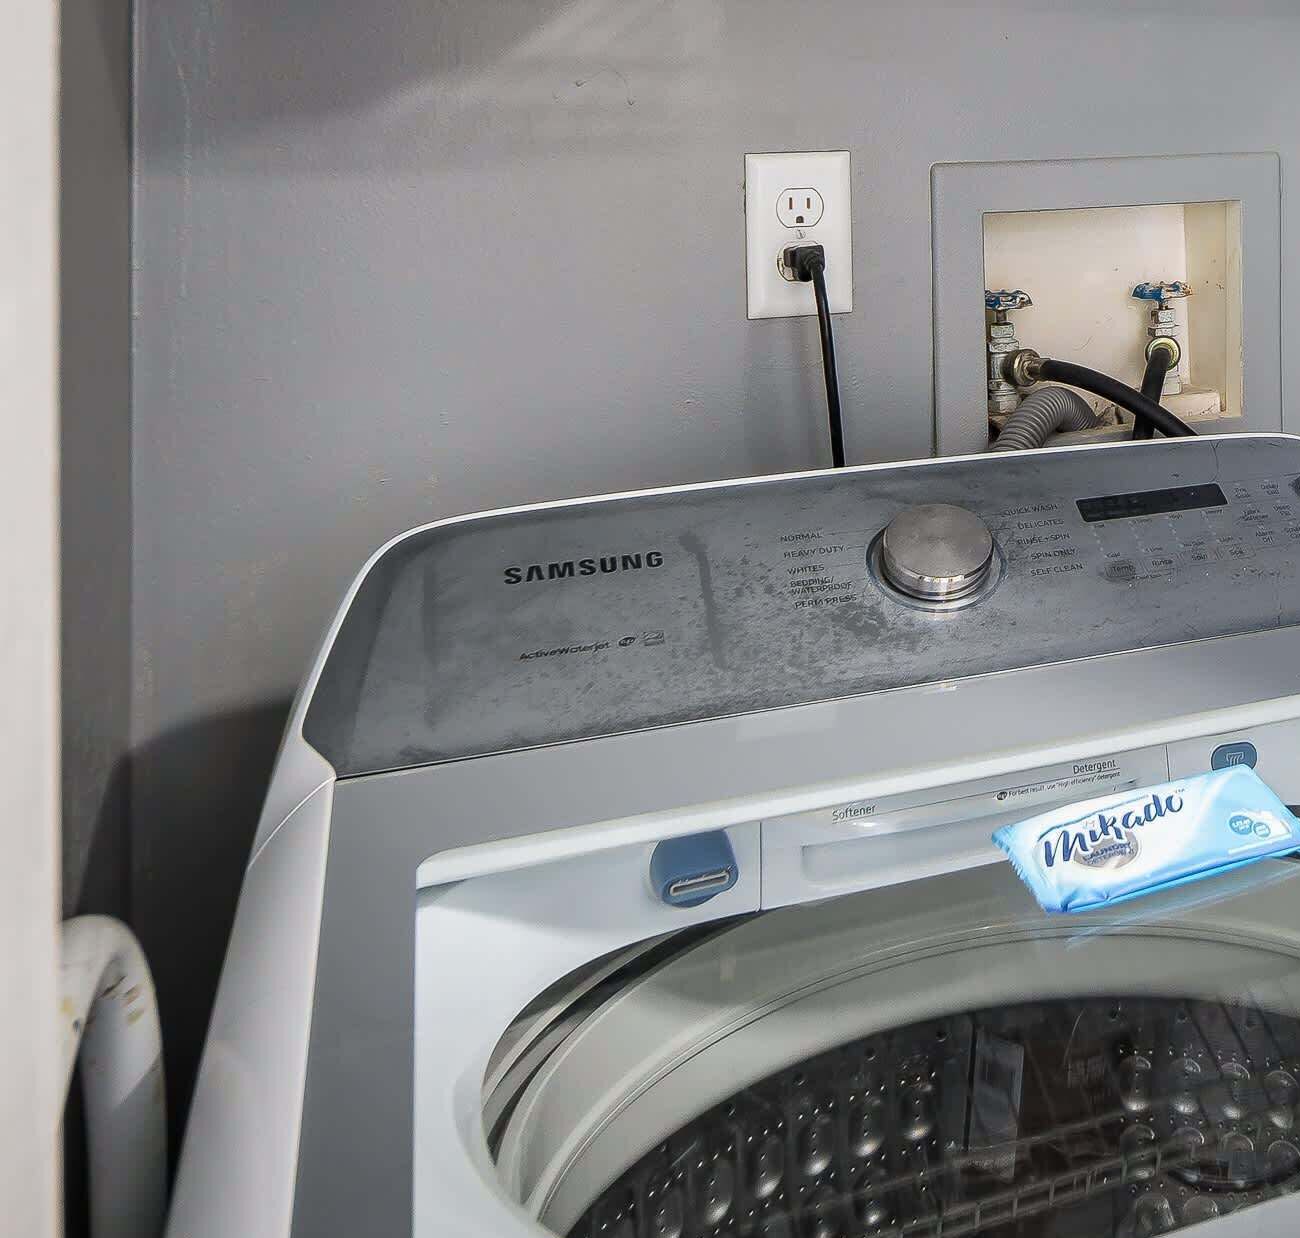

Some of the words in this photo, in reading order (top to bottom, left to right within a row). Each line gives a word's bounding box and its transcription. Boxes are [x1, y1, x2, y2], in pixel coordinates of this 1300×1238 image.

[1032, 503, 1058, 512] WASH
[780, 532, 823, 542] NORMAL
[783, 548, 817, 558] HEAVY
[819, 545, 845, 554] DUTY
[1030, 552, 1052, 560] SPIN
[1054, 548, 1076, 557] ONLY
[503, 551, 664, 585] SAMSUNG
[787, 564, 825, 575] WHITES
[1030, 567, 1053, 577] SELF
[1054, 563, 1083, 573] CLEAN
[790, 582, 852, 596] WATERPROOF
[794, 598, 823, 609] PERM
[825, 593, 857, 605] PRESS
[1073, 760, 1116, 775] Detergent
[832, 805, 876, 821] Softener
[1044, 794, 1184, 868] Mikado
